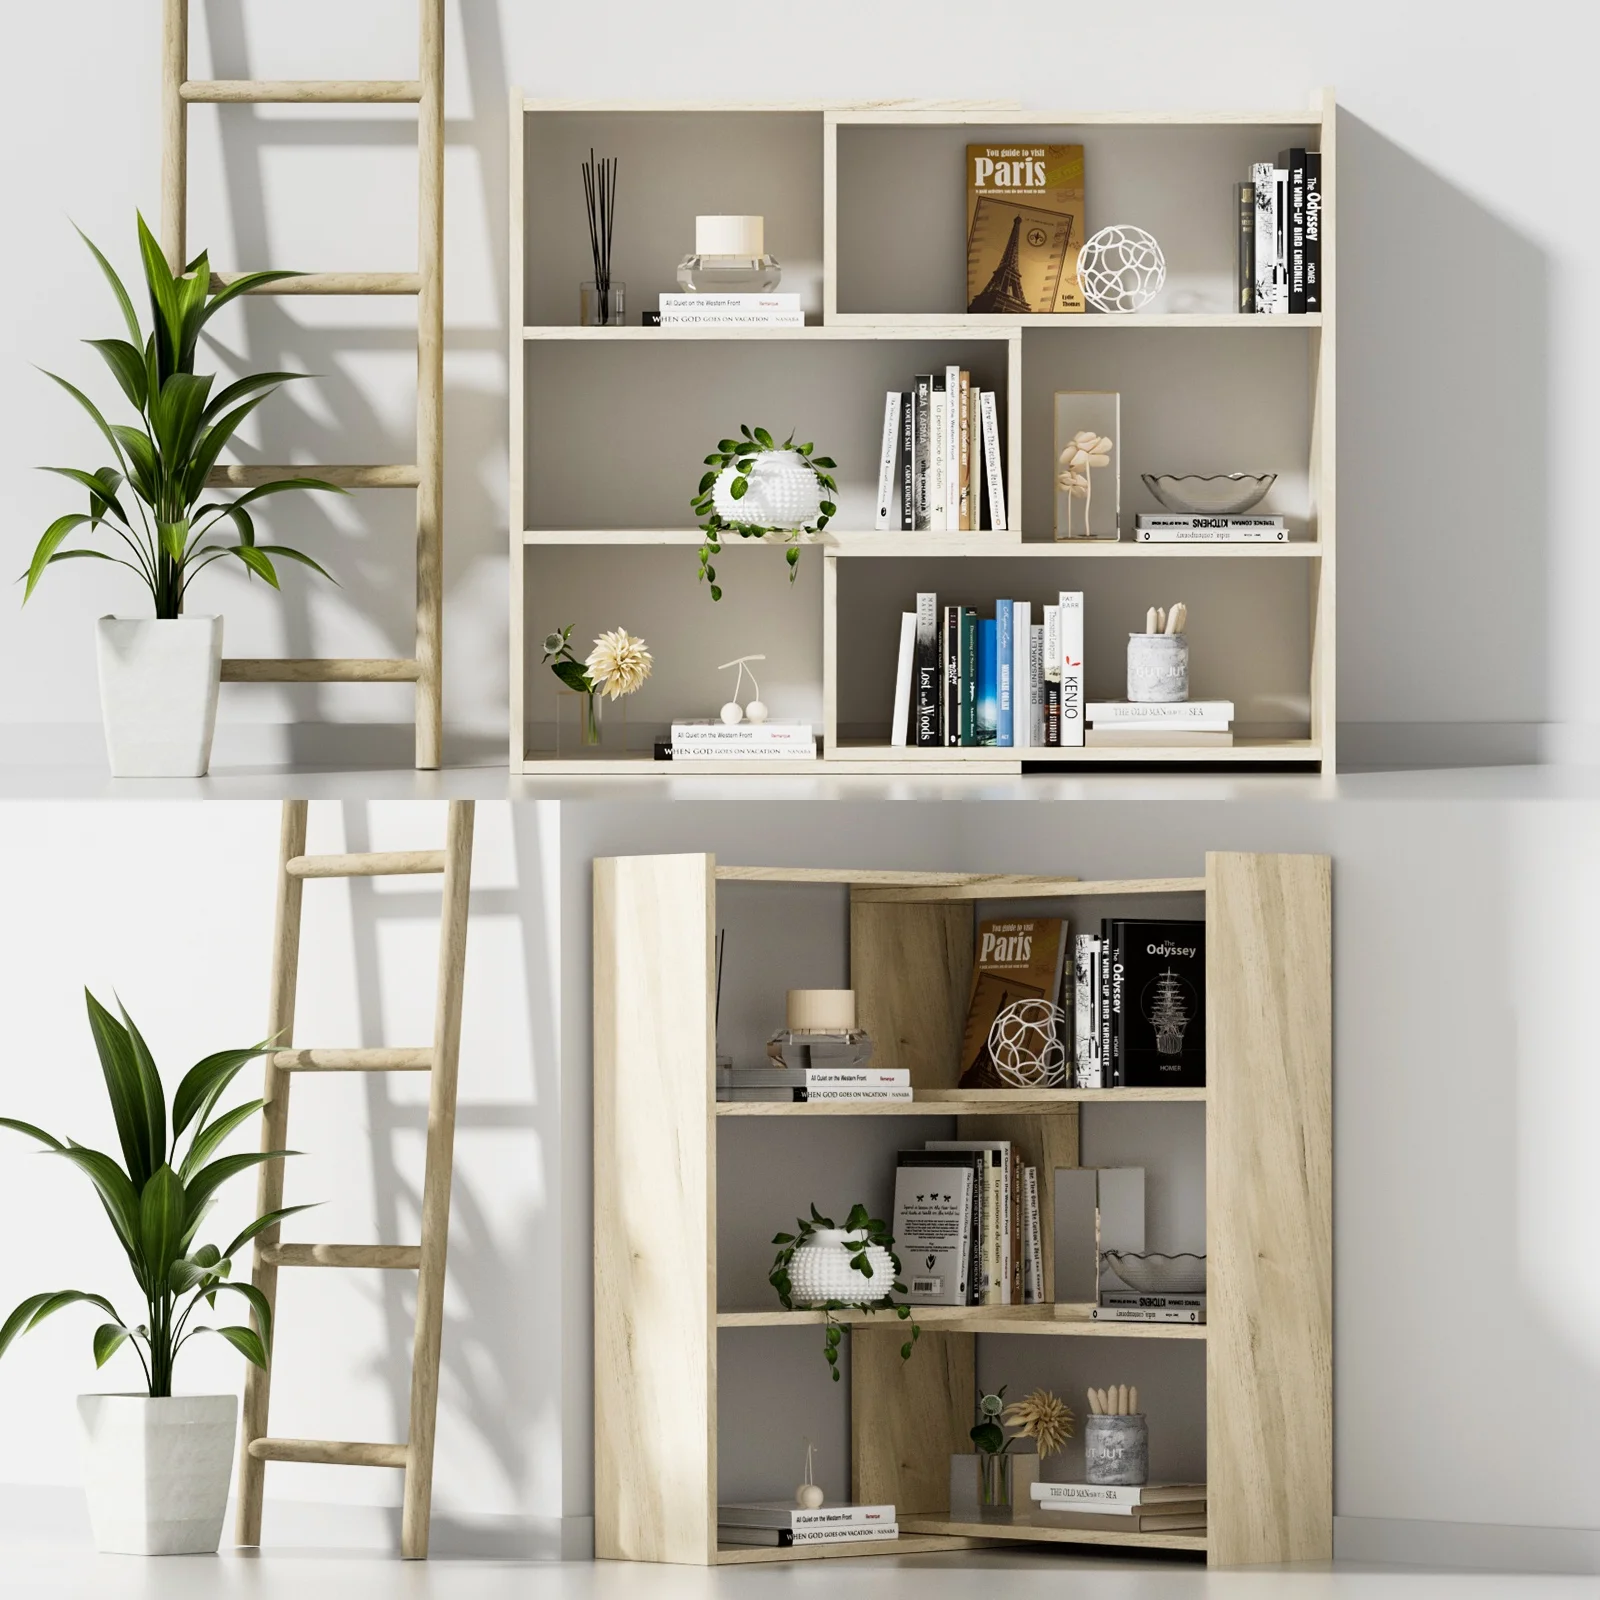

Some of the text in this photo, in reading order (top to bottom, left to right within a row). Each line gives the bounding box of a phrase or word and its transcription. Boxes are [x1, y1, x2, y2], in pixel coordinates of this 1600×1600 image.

[1001, 149, 1020, 157] guide
[975, 157, 1046, 186] Paris
[1307, 178, 1316, 190] The
[1306, 192, 1321, 241] Odyssey
[1293, 168, 1303, 292] THE WIND-UP BIRD CHRONICLE
[936, 457, 943, 465] du
[1192, 519, 1228, 528] KITCHENS
[921, 667, 934, 689] Lost
[1167, 666, 1185, 677] JUT
[1065, 677, 1078, 719] KENJO
[921, 705, 934, 740] Woods
[980, 932, 1033, 962] Paris
[1147, 944, 1196, 958] Odyssey
[1113, 964, 1124, 1013] Odyssey
[995, 1231, 1000, 1240] du
[1139, 1297, 1166, 1307] KITCHENS
[1100, 1448, 1125, 1459] JUT
[1050, 1488, 1062, 1496] THE
[1063, 1488, 1076, 1496] OLD
[1076, 1489, 1090, 1497] MAN
[1106, 1491, 1117, 1499] SEA
